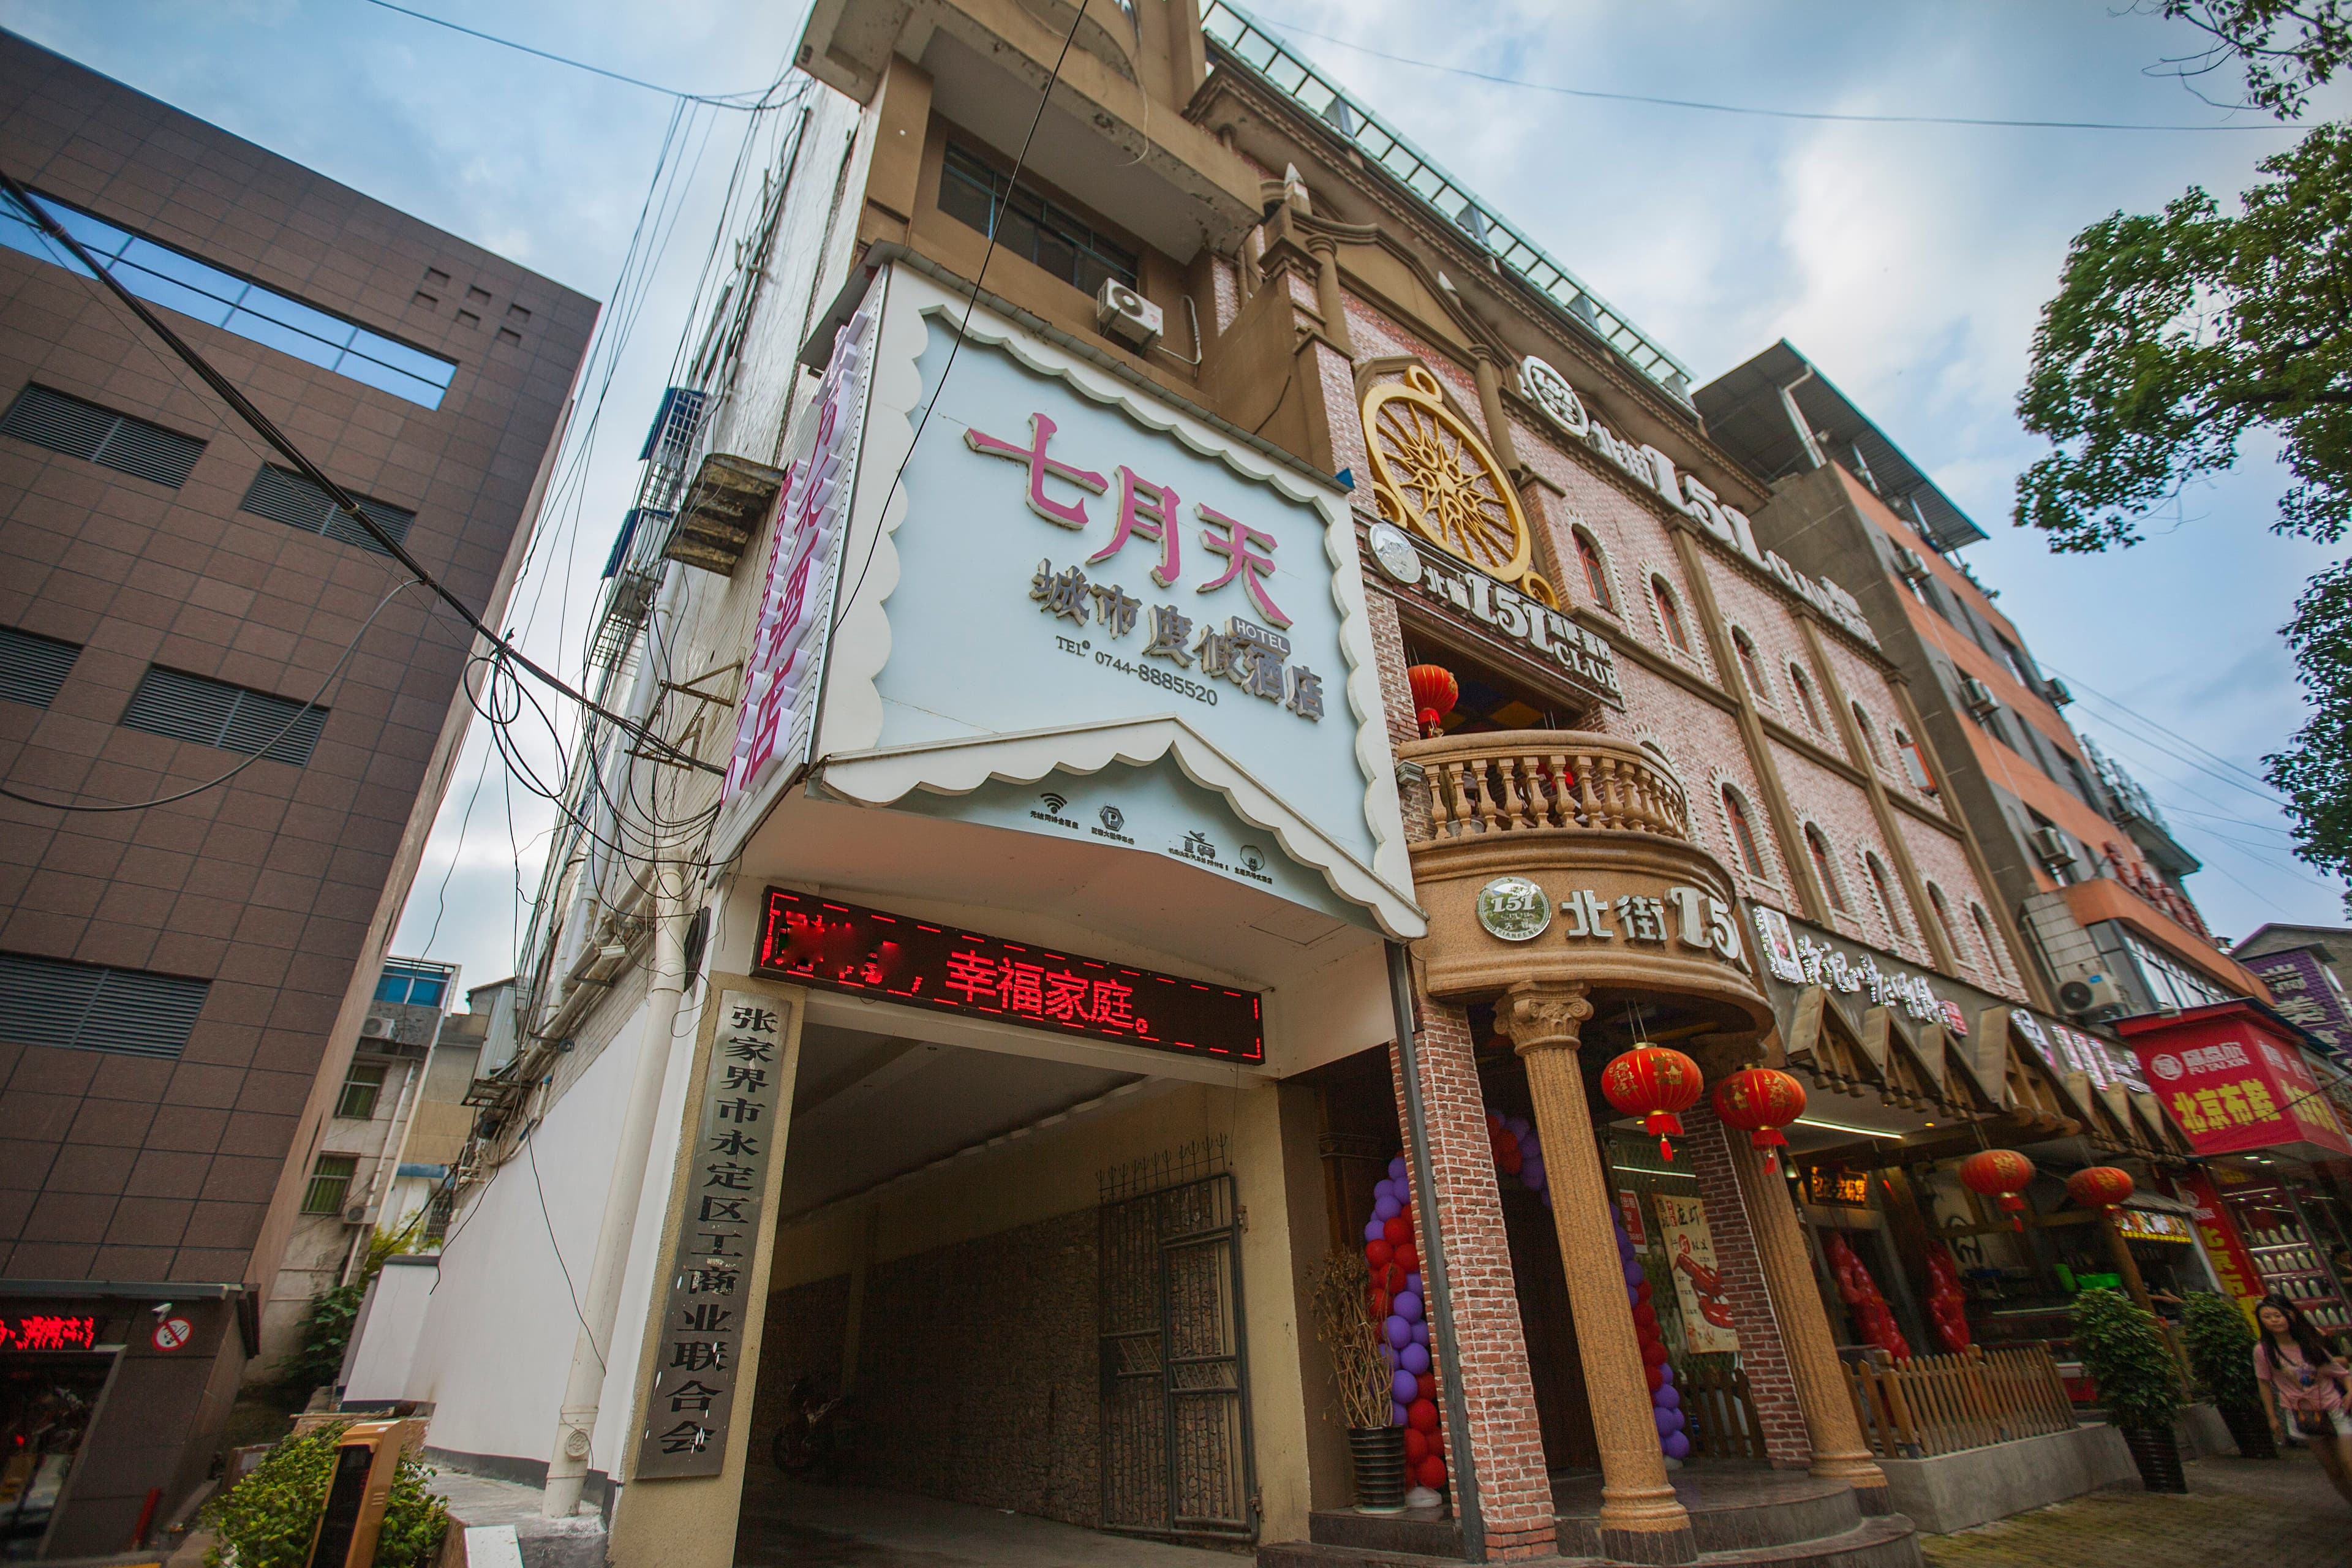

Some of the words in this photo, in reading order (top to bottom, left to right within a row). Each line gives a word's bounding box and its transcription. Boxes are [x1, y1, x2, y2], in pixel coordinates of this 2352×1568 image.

[963, 412, 1294, 630] 七月天
[1030, 557, 1325, 722] 城市度假酒店
[1235, 620, 1289, 652] HOTEL
[1095, 650, 1218, 706] 0744-8885520
[1555, 641, 1622, 695] CLUB
[1490, 893, 1536, 913] 151
[2172, 1079, 2283, 1134] 北京布鞋
[658, 1005, 779, 1455] 张家界市永定区工商业联合会
